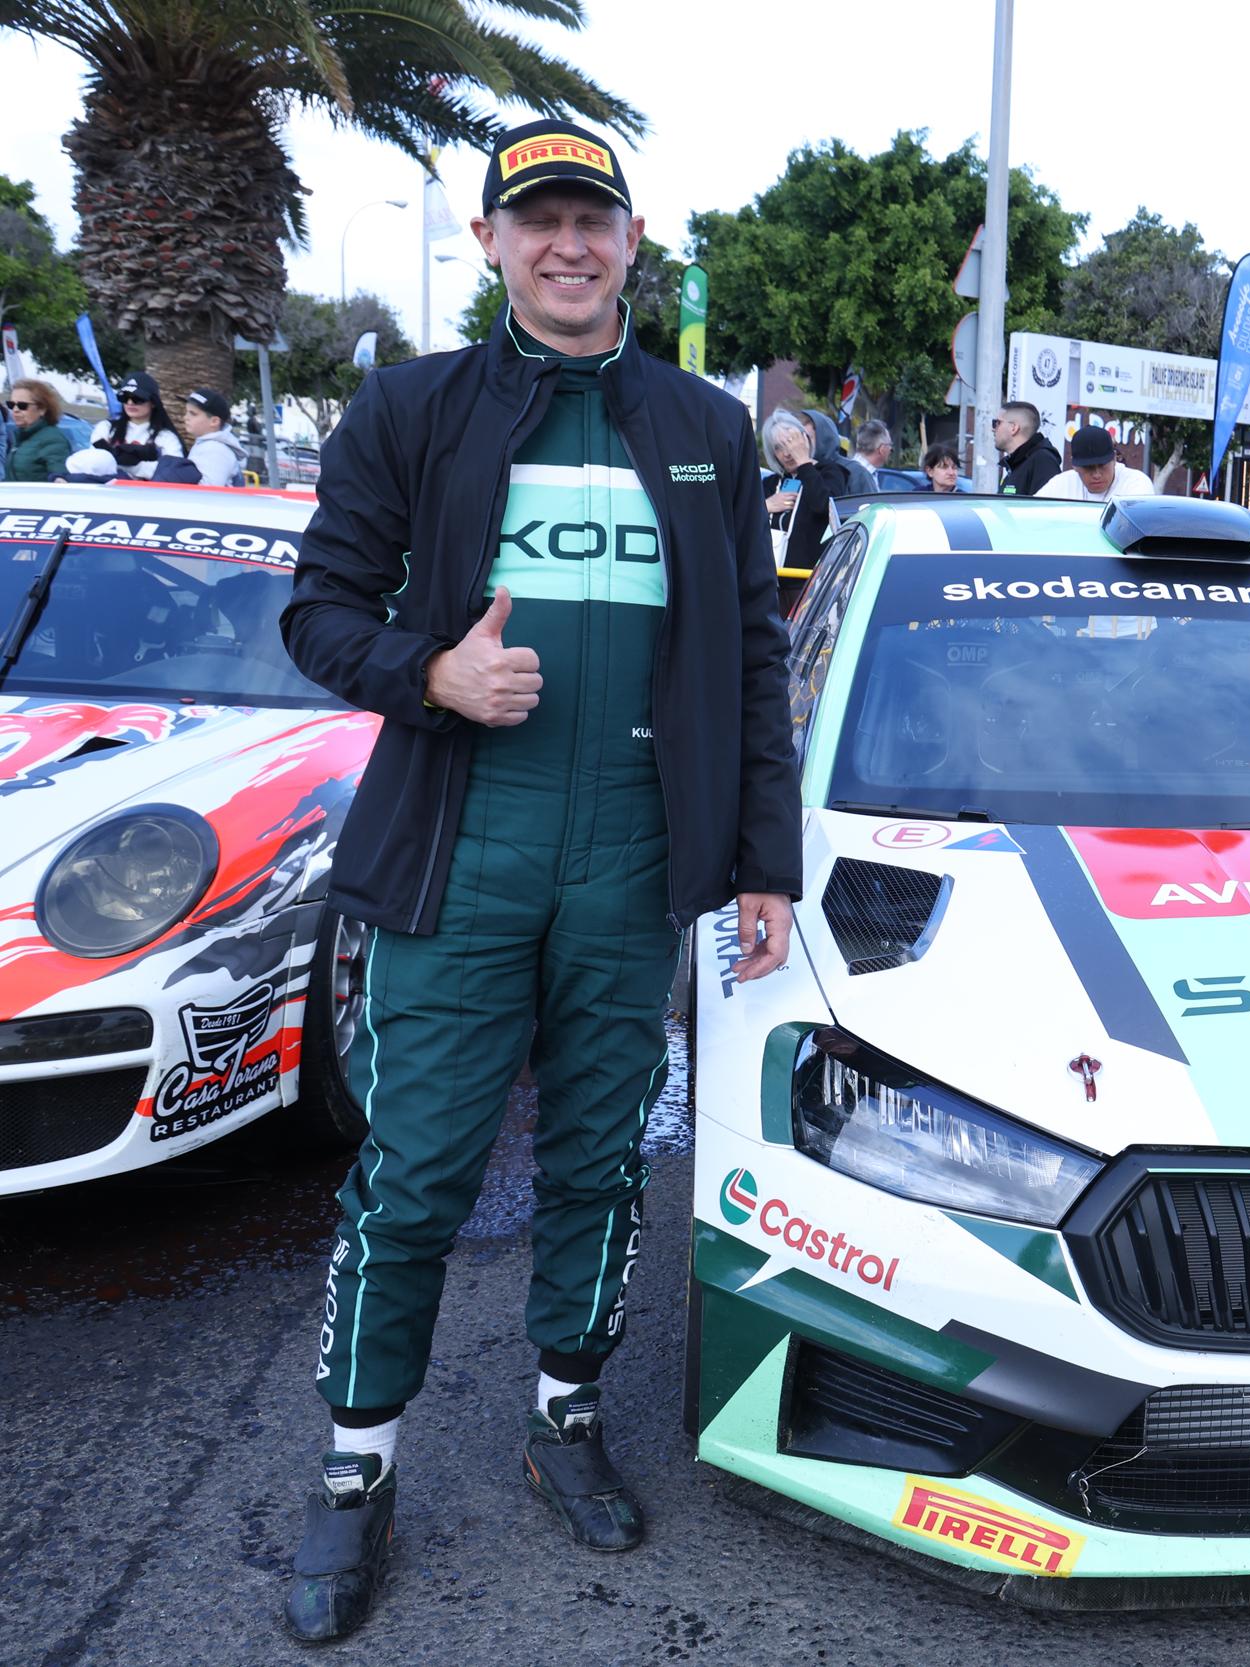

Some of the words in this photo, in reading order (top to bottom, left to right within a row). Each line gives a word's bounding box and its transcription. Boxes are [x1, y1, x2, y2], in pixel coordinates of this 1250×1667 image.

[507, 138, 606, 171] PIRELLI
[1009, 346, 1019, 402] Orvecame
[668, 463, 715, 473] SKODA
[671, 473, 716, 484] Motorspor
[0, 509, 298, 563] EÑALCON
[0, 531, 161, 548] ALIZCIONES
[167, 541, 297, 568] CONEJERA
[494, 520, 661, 564] KOD
[947, 646, 987, 662] OMP
[631, 727, 654, 738] KUL
[891, 827, 930, 842] E
[200, 1016, 223, 1030] Desde
[222, 1013, 241, 1027] 1981
[153, 1075, 278, 1137] RESTAURANT
[155, 1065, 221, 1118] Casa
[759, 1198, 900, 1292] Castrol
[315, 1233, 350, 1381] SKODA
[902, 1486, 1071, 1574] PIRELLI
